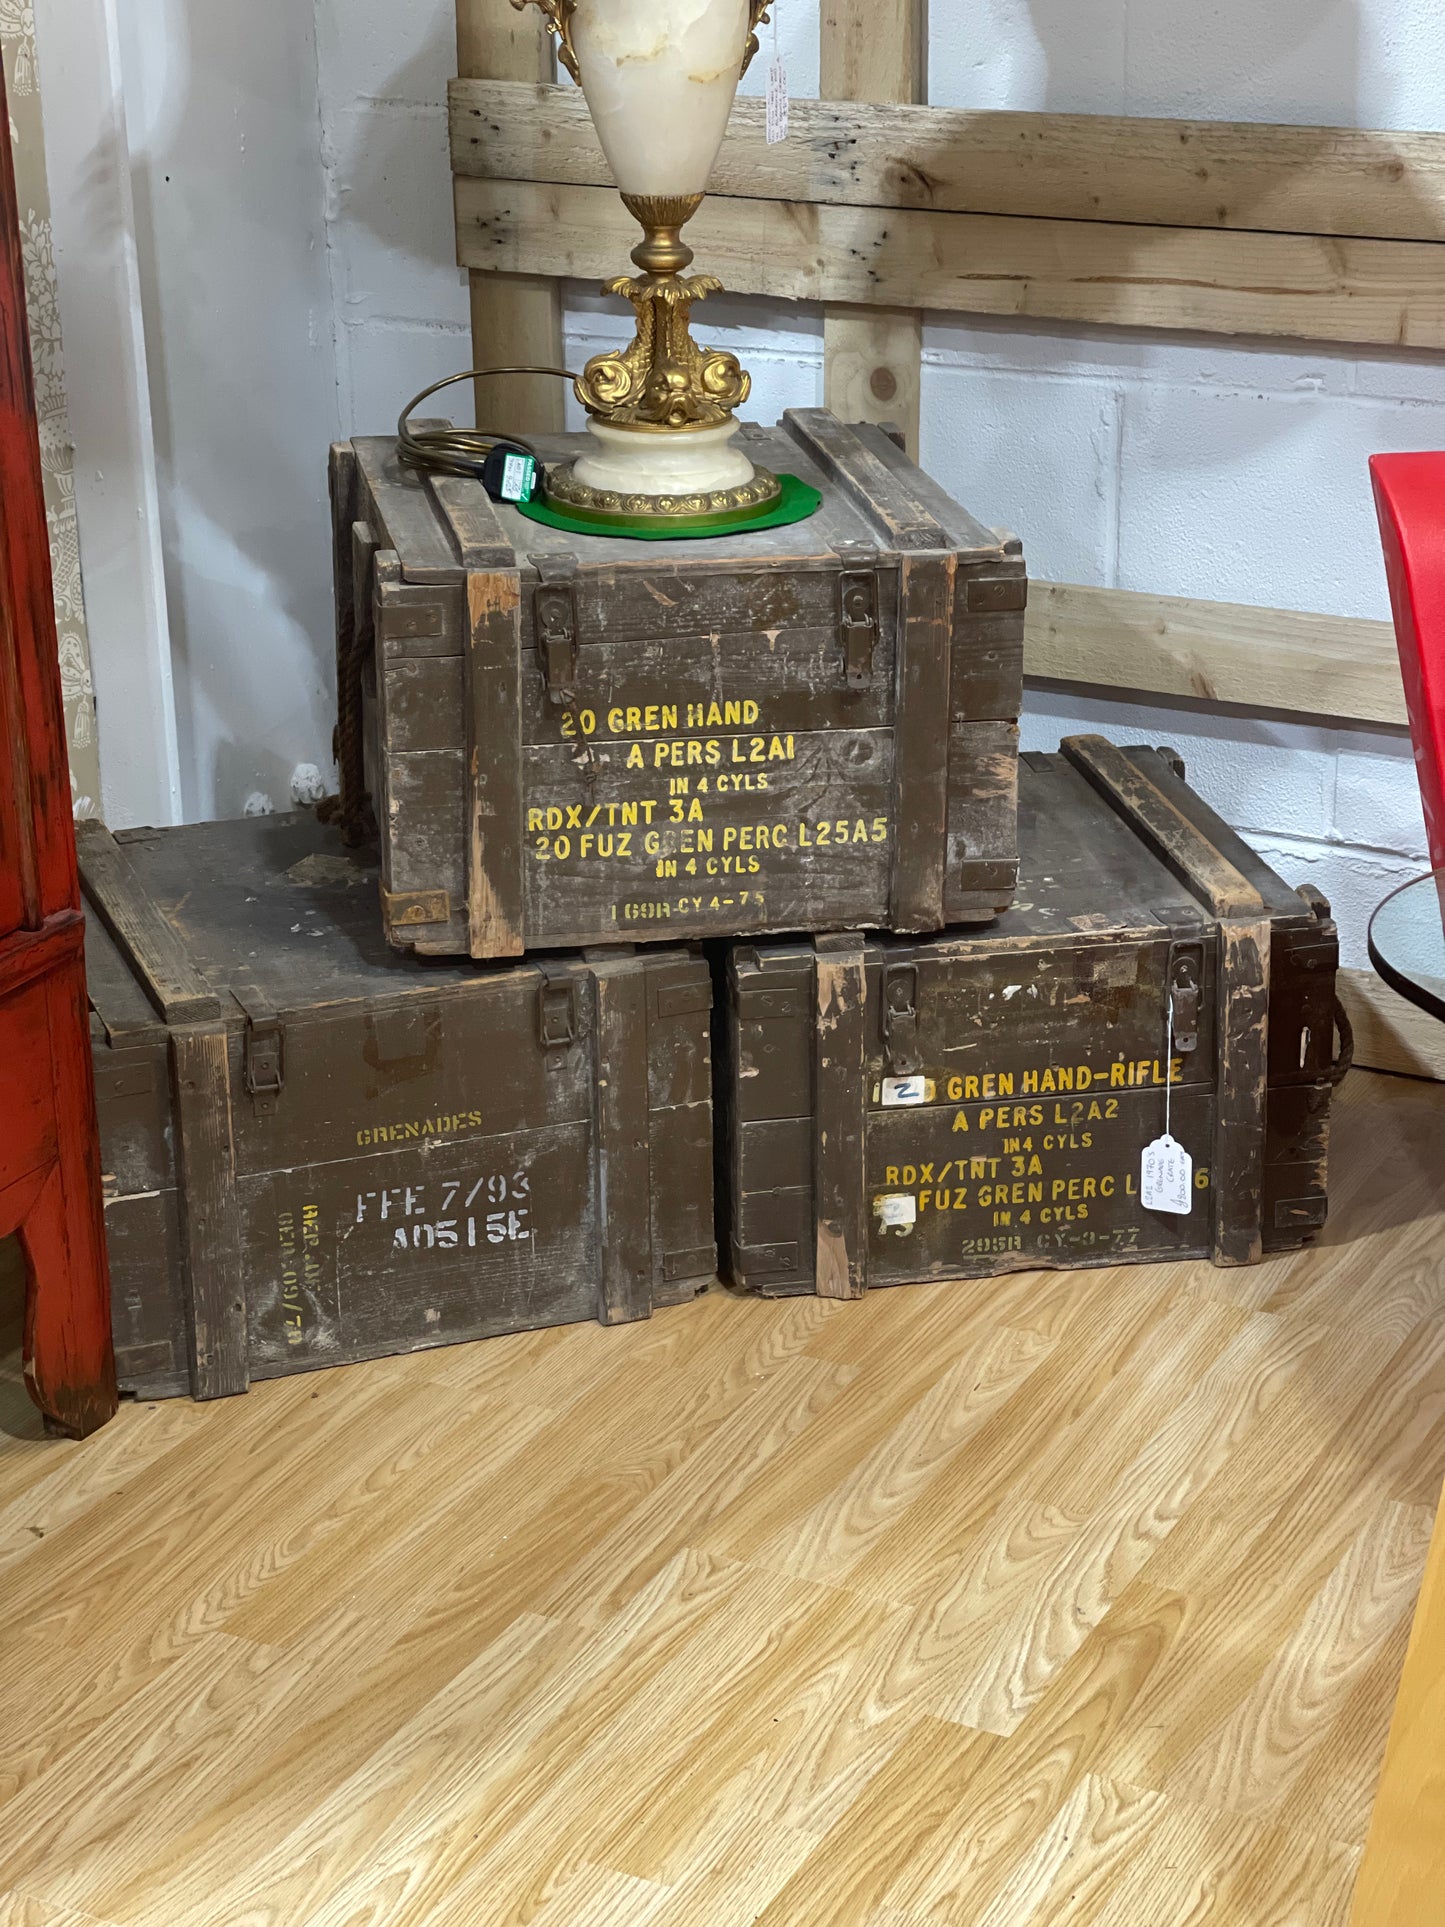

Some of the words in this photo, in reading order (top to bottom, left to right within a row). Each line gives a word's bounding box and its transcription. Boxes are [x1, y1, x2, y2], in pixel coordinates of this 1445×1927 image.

[561, 710, 596, 736] 20
[607, 705, 678, 733] GREN
[687, 700, 759, 728] HAND
[626, 744, 645, 768] A
[654, 740, 720, 767] PERS
[669, 777, 689, 795] IN
[697, 777, 709, 793] 4
[717, 773, 768, 791] CYLS
[528, 801, 657, 831] RDX/TNT
[669, 799, 703, 823] 3A
[535, 835, 571, 860] 20
[580, 833, 632, 858] FUZ
[645, 829, 713, 855] GREN
[723, 824, 788, 850] PERC
[800, 817, 888, 846] L25A5
[656, 859, 677, 877] IN
[685, 858, 697, 875] 4
[706, 855, 760, 873] CYLS
[947, 1073, 1014, 1100] GREN
[1023, 1059, 1184, 1093] HAND-RIFLE
[356, 1111, 483, 1146] GRENADES
[952, 1111, 969, 1132] A
[979, 1105, 1043, 1129] PERS
[1055, 1099, 1119, 1124] L2A2
[1043, 1133, 1093, 1150] CYLS
[886, 1156, 1001, 1185] RDX/TNT
[1011, 1154, 1043, 1177] 3A
[356, 1185, 425, 1223] FFE
[441, 1171, 530, 1211] 7/93
[919, 1189, 967, 1211] FUZ
[979, 1181, 1043, 1207] GREN
[1052, 1175, 1114, 1200] PERC
[993, 1210, 1011, 1226] IN
[1020, 1208, 1031, 1224] 4
[1040, 1204, 1089, 1223] CYLS
